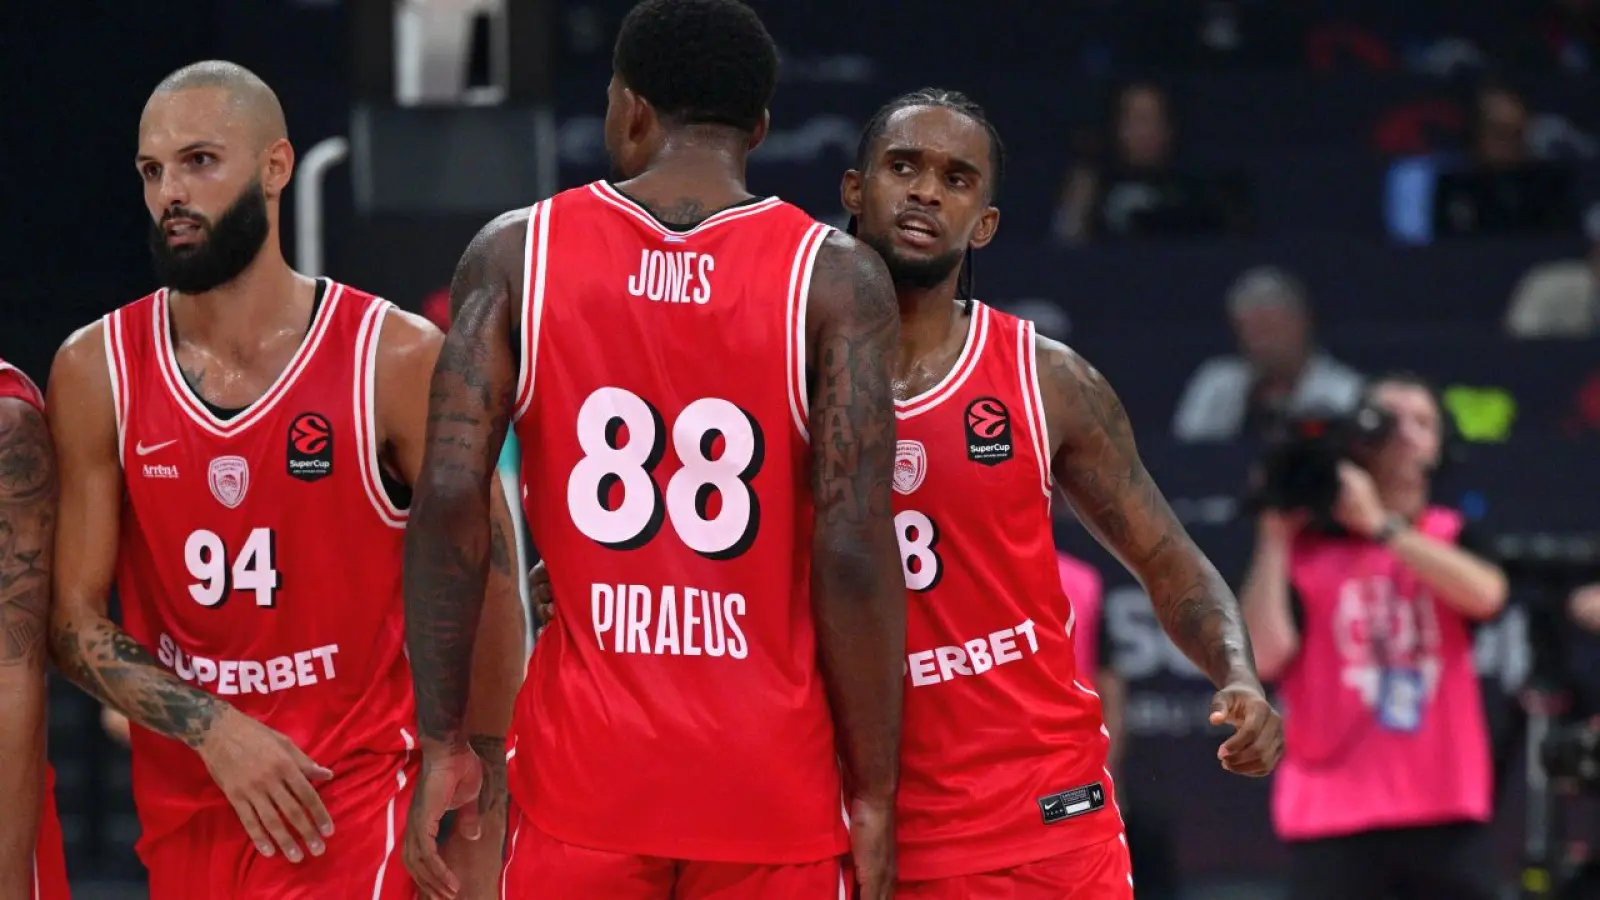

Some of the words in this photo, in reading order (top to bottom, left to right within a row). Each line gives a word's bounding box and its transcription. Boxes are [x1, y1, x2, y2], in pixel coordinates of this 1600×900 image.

[627, 248, 715, 305] JONES
[289, 459, 331, 469] SuperCup
[567, 386, 764, 560] 88
[969, 443, 1011, 454] SuperCup
[184, 527, 281, 608] 94
[894, 510, 944, 592] 8
[591, 582, 748, 660] PIRAEUS
[158, 632, 338, 696] SUPERBET
[1093, 790, 1101, 801] M
